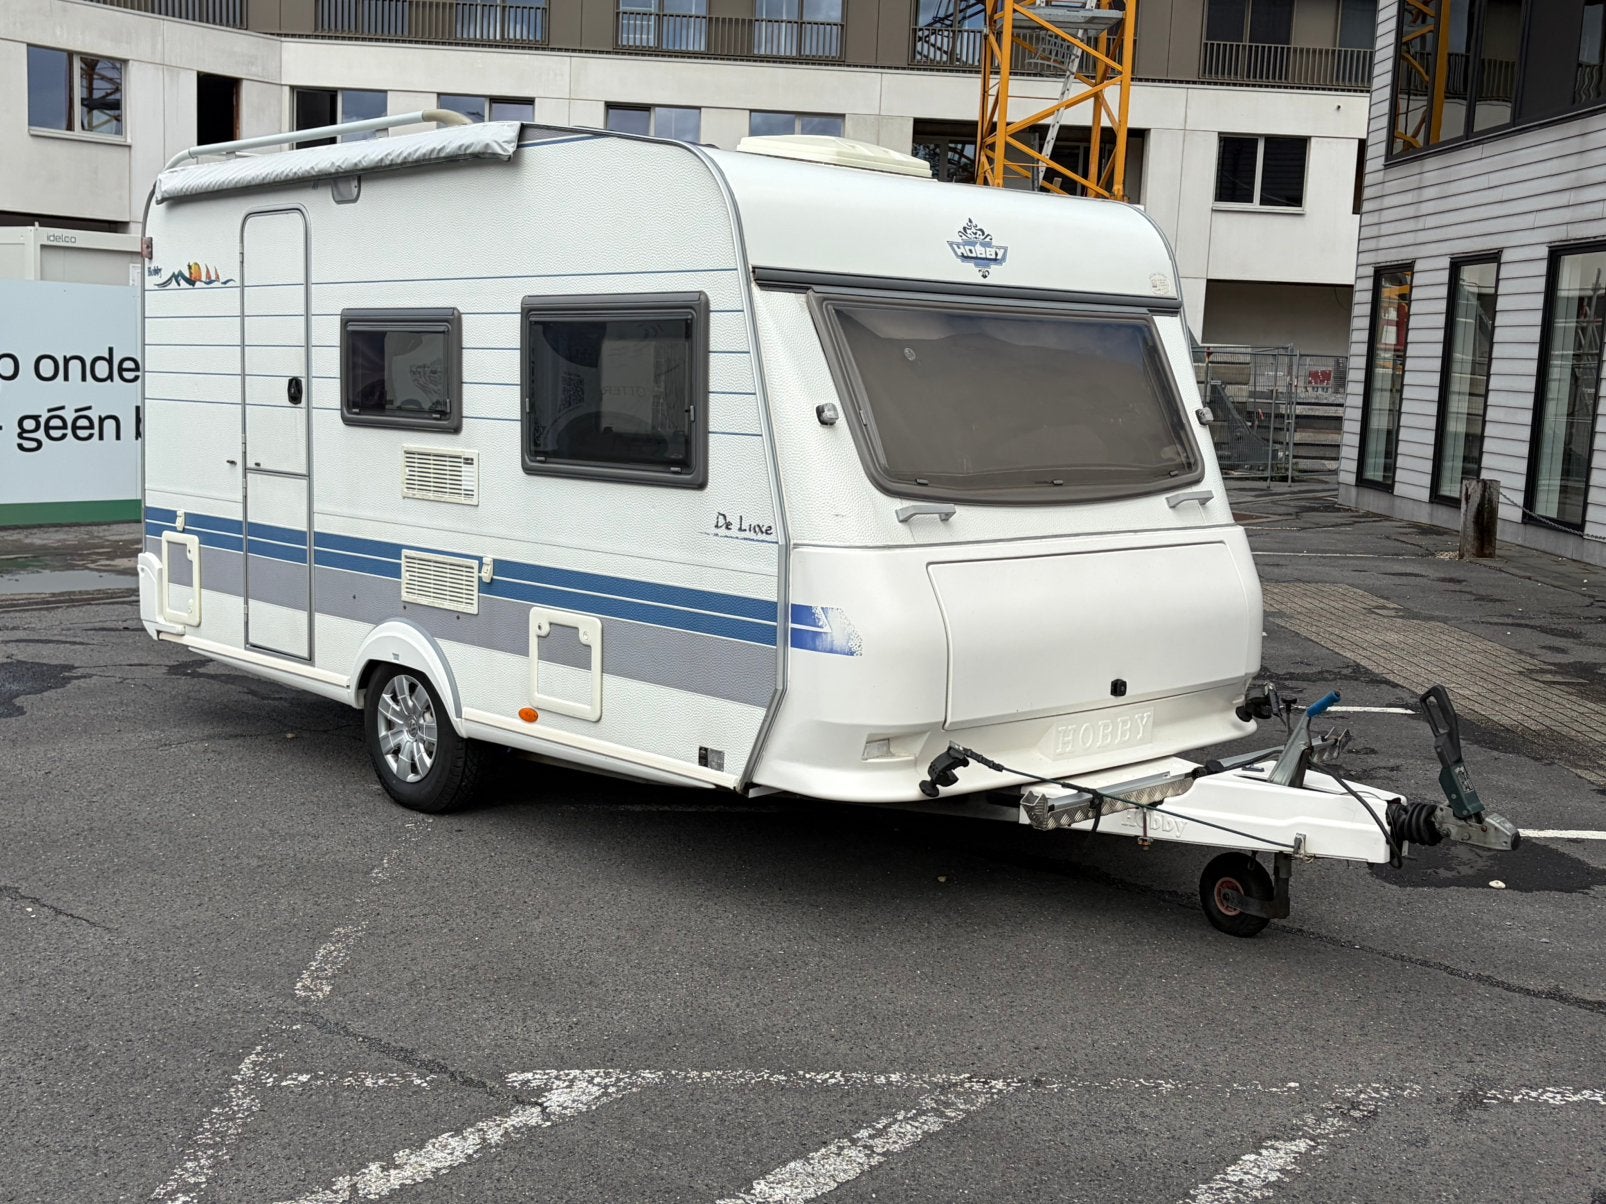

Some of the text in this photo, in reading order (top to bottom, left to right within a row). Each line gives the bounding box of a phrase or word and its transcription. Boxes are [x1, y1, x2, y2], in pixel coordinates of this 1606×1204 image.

[952, 243, 1006, 260] HOBBY
[16, 404, 122, 453] géén
[714, 511, 773, 536] De Luxe
[1055, 710, 1152, 755] HOBBY
